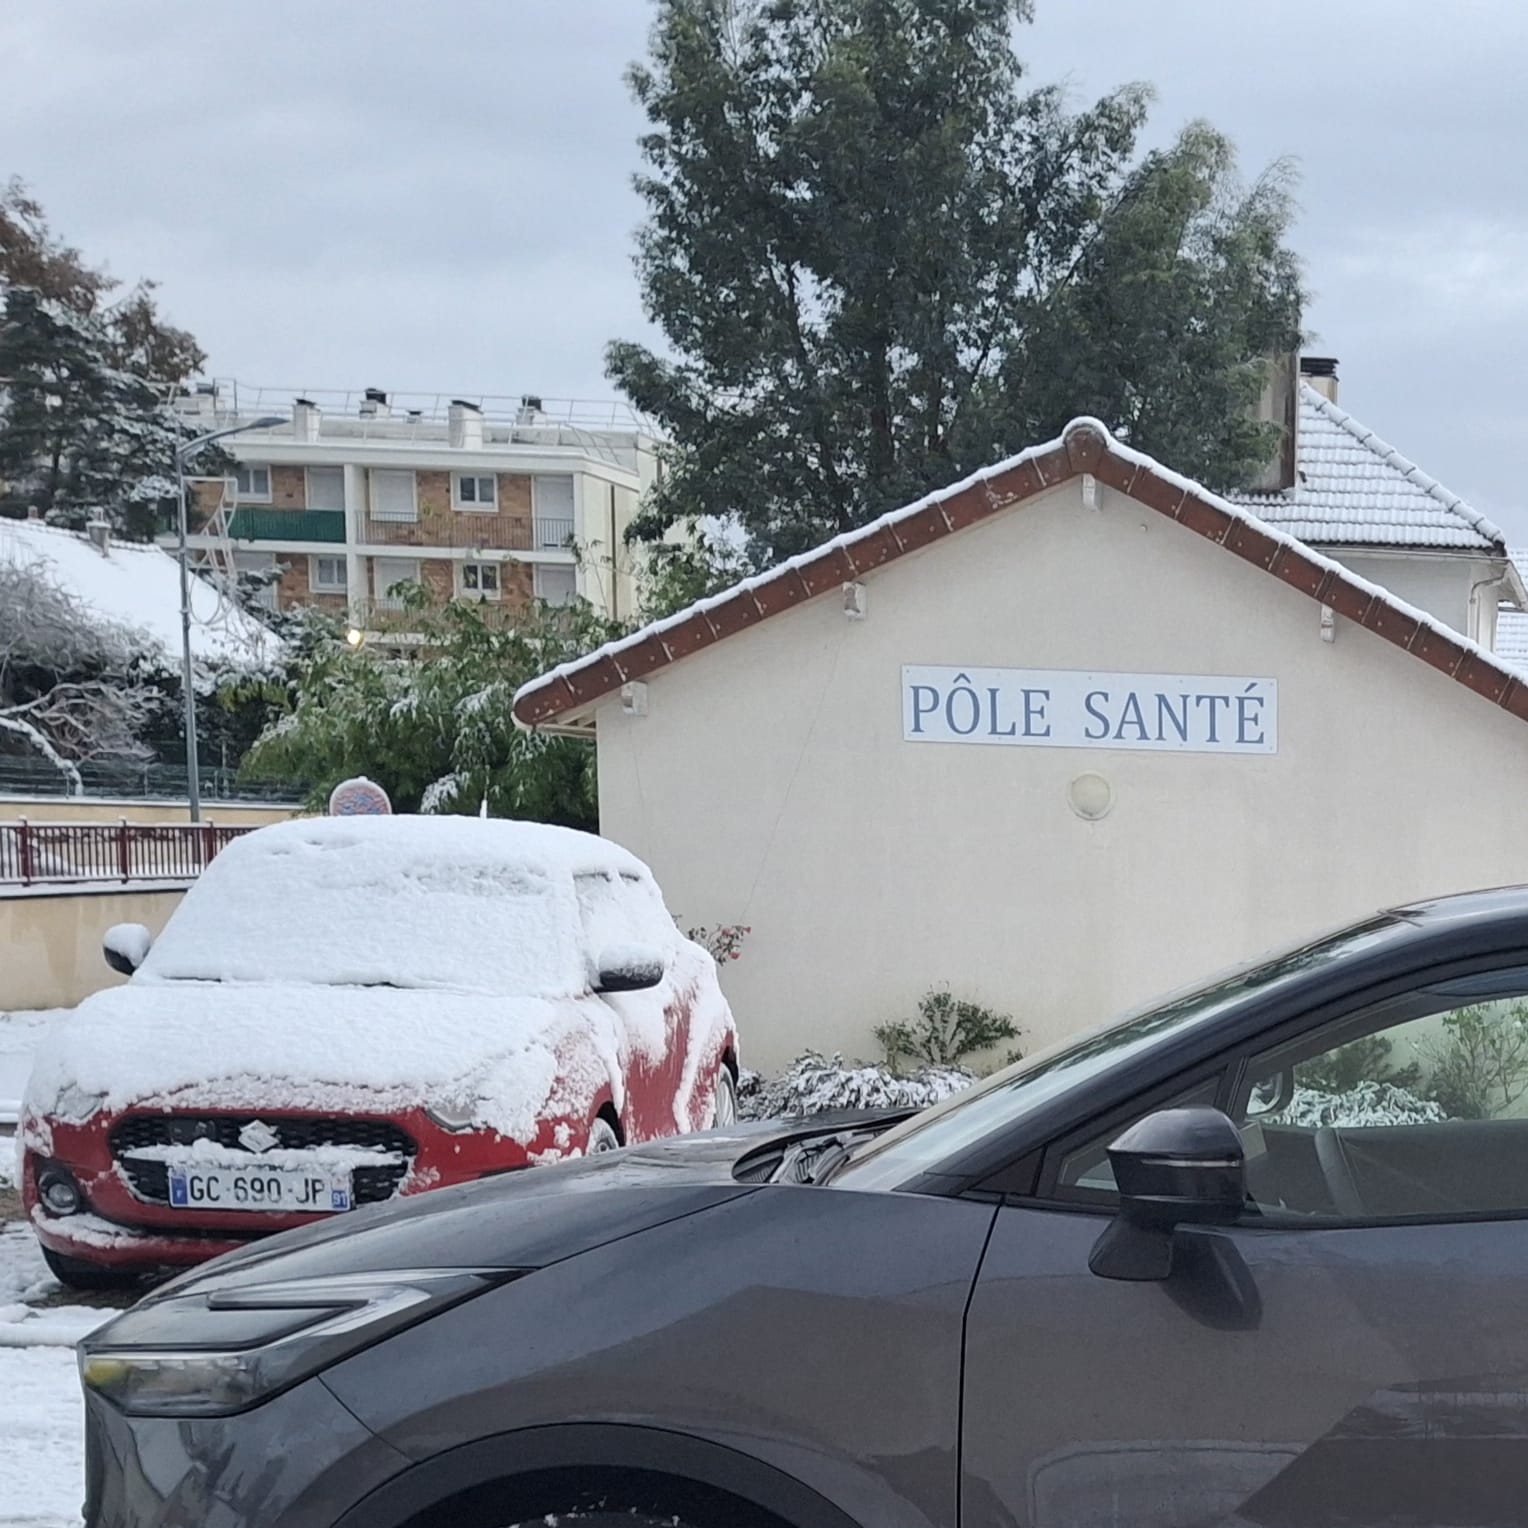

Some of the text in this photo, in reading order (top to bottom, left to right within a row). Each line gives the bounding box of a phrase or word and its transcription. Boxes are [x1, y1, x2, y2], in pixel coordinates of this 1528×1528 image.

[909, 673, 1265, 745] PÔLE SANTÉ
[333, 1192, 347, 1205] 91
